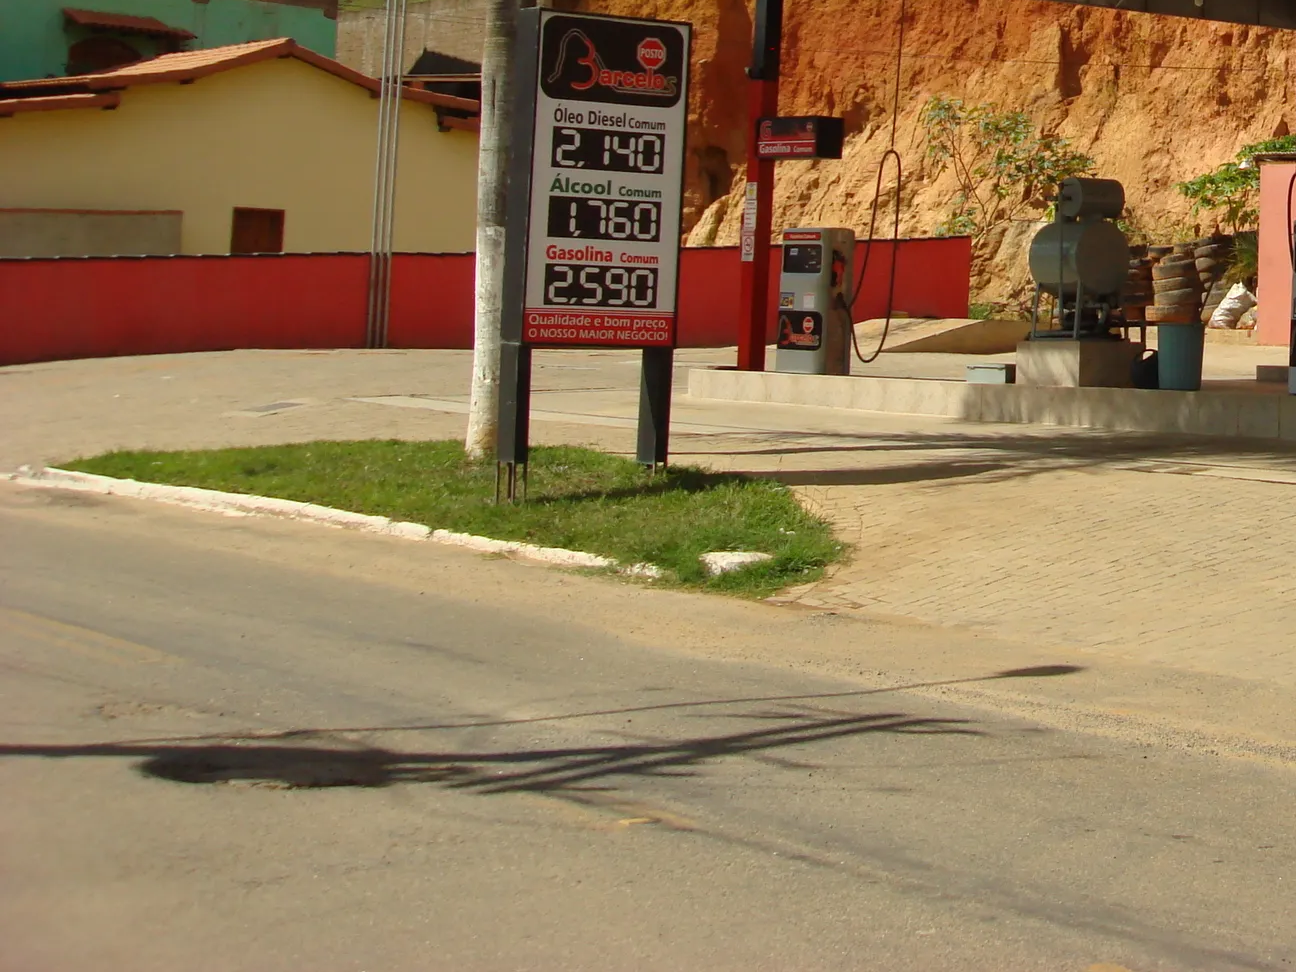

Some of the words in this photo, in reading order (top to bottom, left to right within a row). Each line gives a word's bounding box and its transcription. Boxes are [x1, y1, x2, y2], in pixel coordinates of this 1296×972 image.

[640, 47, 664, 60] POSTO
[565, 35, 677, 96] Barcelos
[554, 103, 584, 125] Óleo
[588, 110, 627, 128] Diesel
[628, 117, 666, 131] Comum
[760, 120, 772, 141] G
[556, 128, 661, 172] 2,140
[759, 143, 791, 154] Gasolina
[549, 173, 612, 196] Álcool
[618, 185, 662, 199] Comum
[569, 200, 658, 240] 1,760
[545, 244, 613, 263] Gasolina
[620, 252, 660, 265] Comum
[548, 265, 655, 306] 2,590
[528, 313, 592, 326] Qualidade
[593, 316, 602, 326] e
[604, 316, 631, 327] bom
[633, 319, 669, 330] preço,
[528, 327, 538, 339] O
[539, 327, 577, 339] NOSSO
[578, 329, 614, 340] MAIOR
[616, 329, 668, 341] NEGÓCIO!
